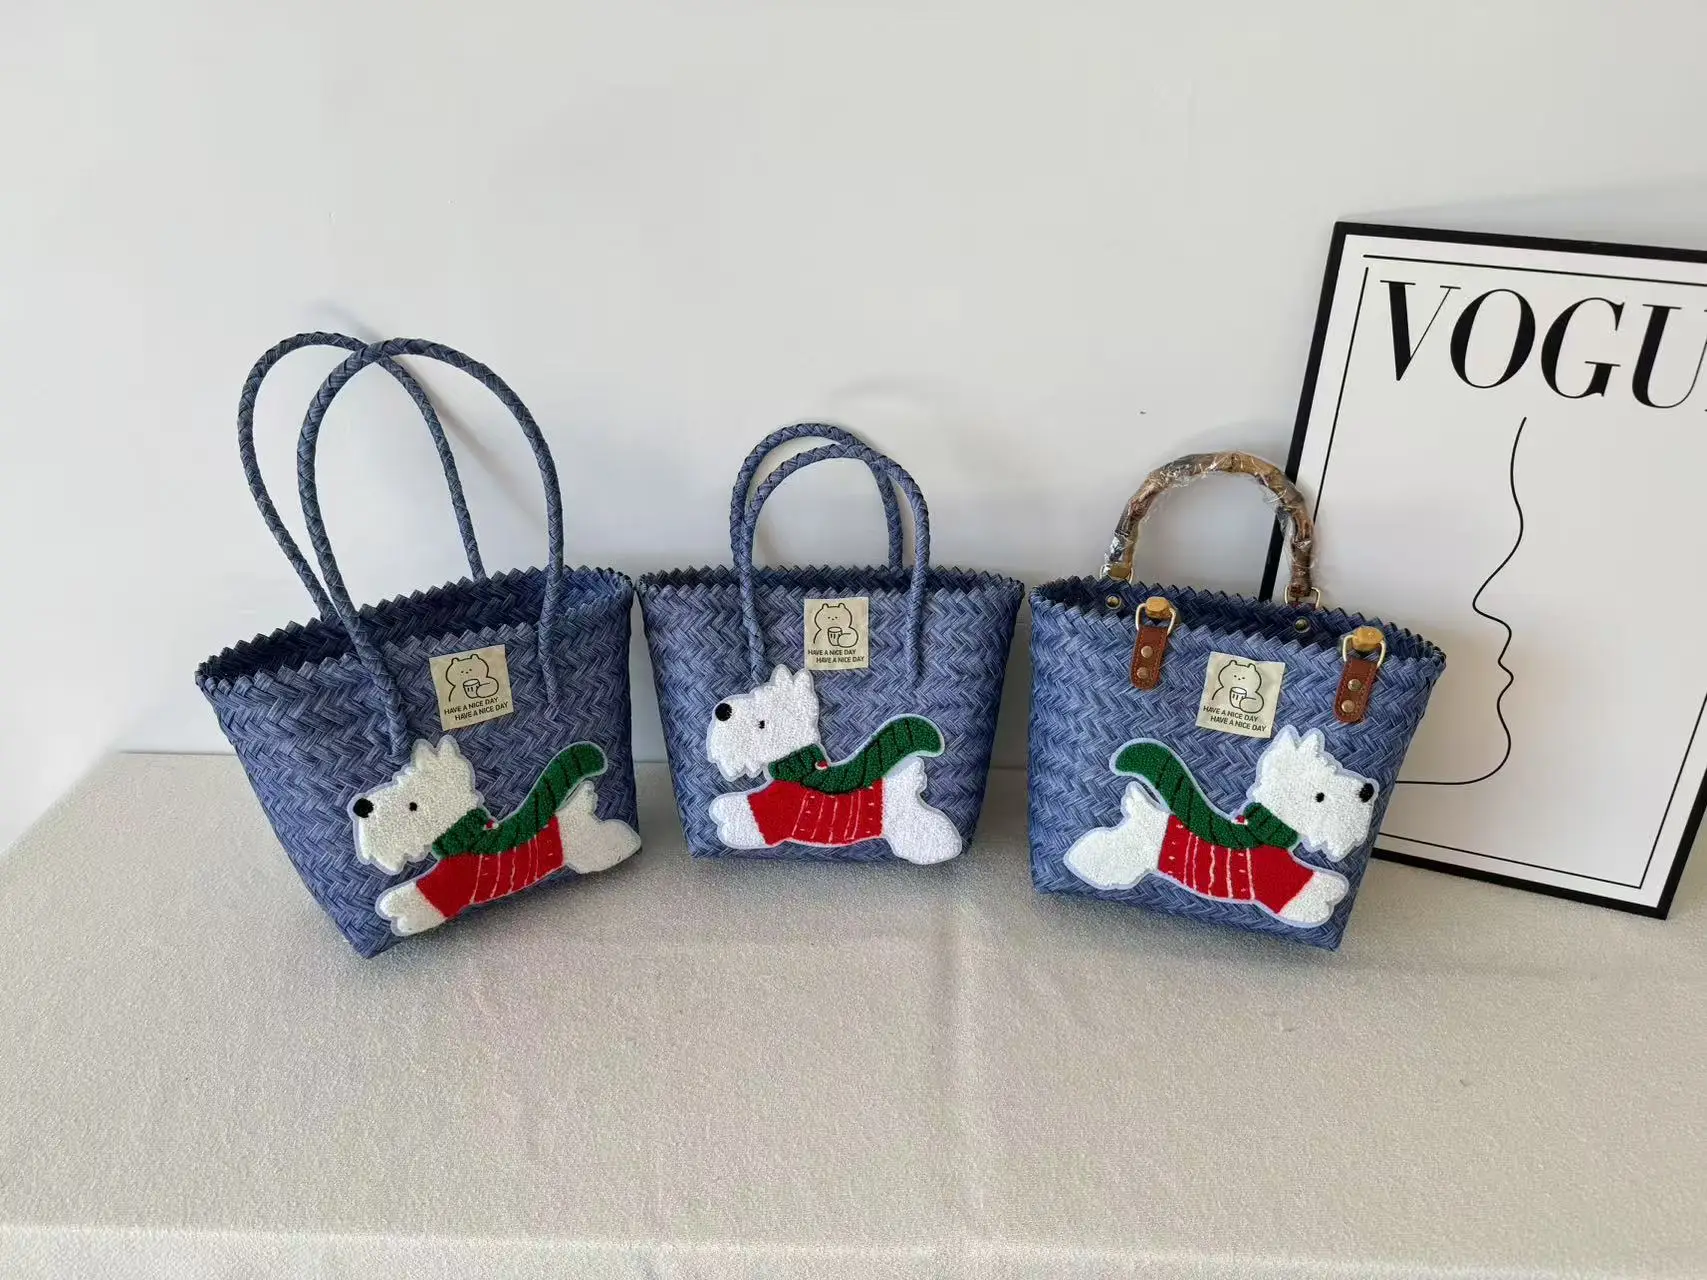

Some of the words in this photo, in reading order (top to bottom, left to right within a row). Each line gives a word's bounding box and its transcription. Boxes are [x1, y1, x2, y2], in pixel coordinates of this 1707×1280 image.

[1380, 280, 1707, 412] VOGU
[444, 705, 462, 715] HAVE
[468, 702, 484, 710] NICE
[485, 696, 499, 705] DAY
[454, 711, 472, 720] HAVE
[479, 706, 495, 714] NICE
[496, 702, 508, 711] DAY
[1203, 706, 1220, 714] HAVE
[1227, 711, 1242, 720] NICE
[1210, 716, 1228, 724] HAVE
[1234, 721, 1250, 730] NICE
